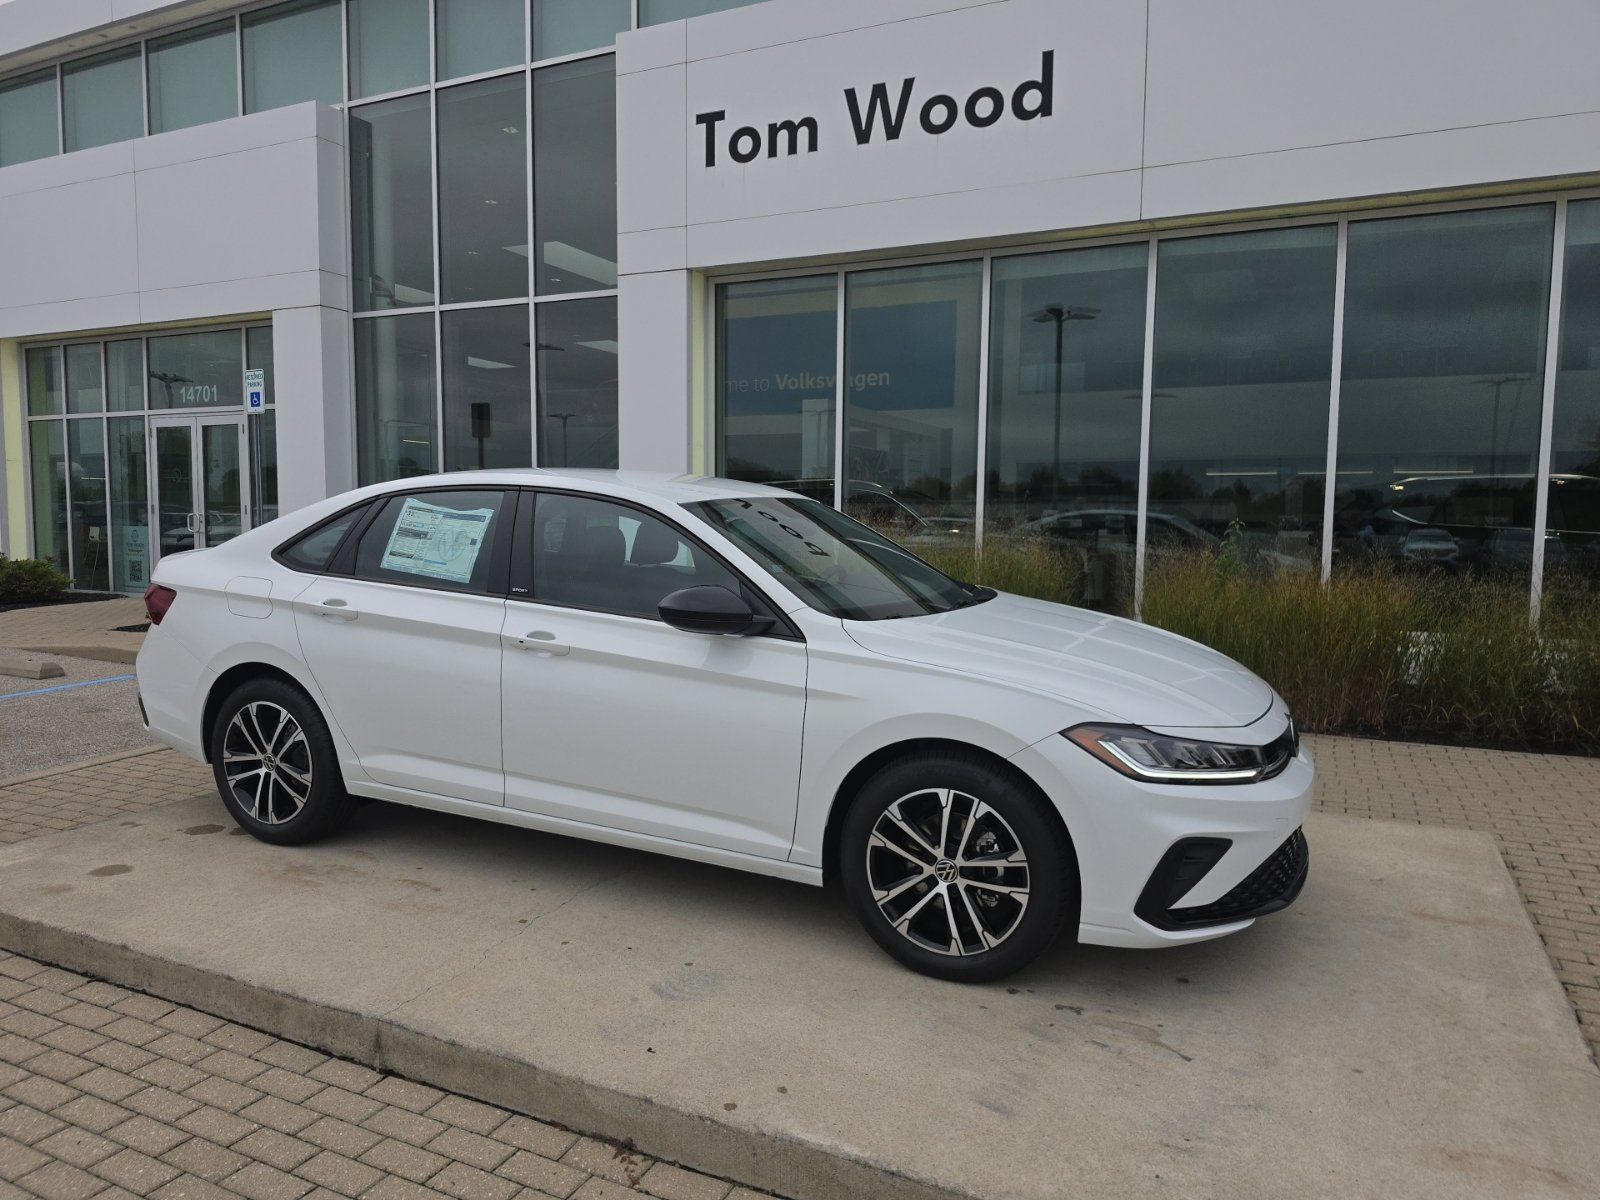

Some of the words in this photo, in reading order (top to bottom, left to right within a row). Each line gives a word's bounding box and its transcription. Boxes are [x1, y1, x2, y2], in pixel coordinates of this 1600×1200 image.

[696, 110, 818, 167] Tom
[844, 49, 1054, 145] Wood
[180, 385, 217, 403] 14701
